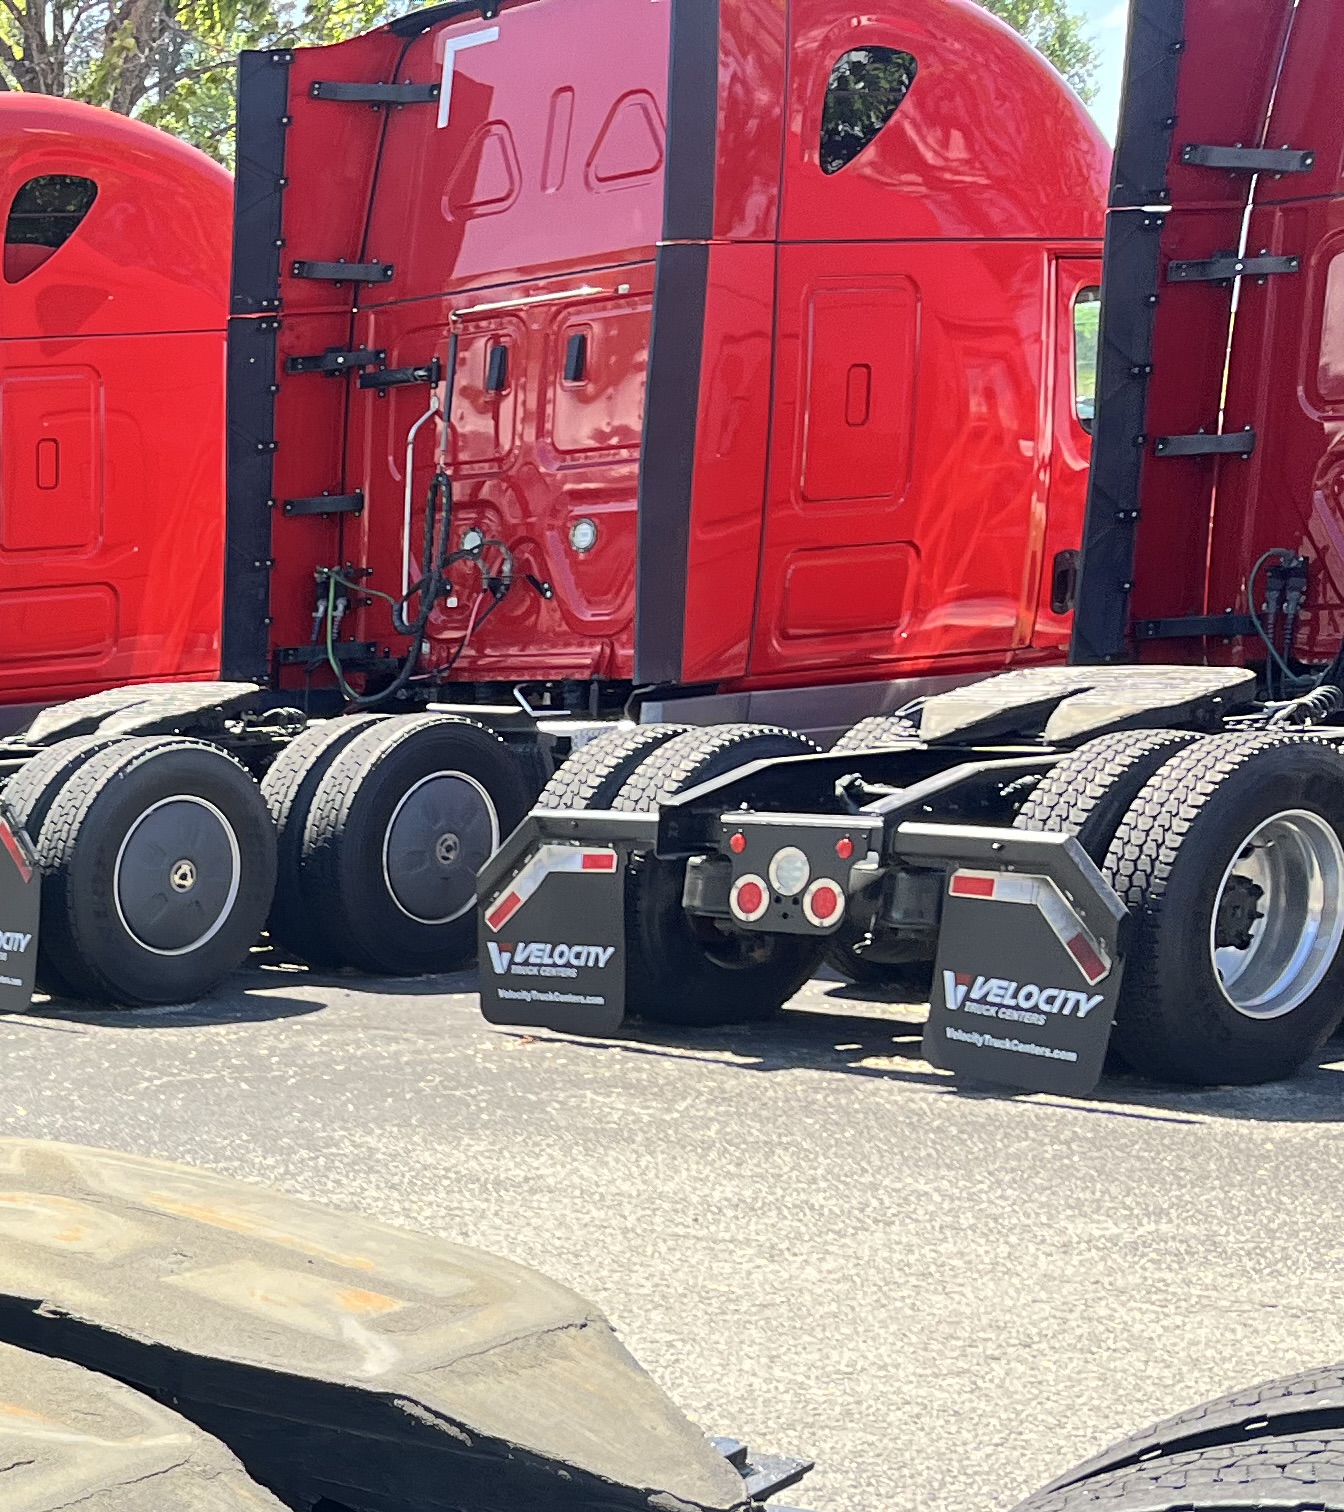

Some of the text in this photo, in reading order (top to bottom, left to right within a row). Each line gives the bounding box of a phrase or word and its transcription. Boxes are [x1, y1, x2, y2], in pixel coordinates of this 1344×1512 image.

[513, 942, 615, 968] VELOCITY
[969, 975, 1105, 1018] VELOCITY
[964, 1001, 1047, 1026] TRUCK CENTERS
[945, 1026, 1078, 1062] VelocityTruckCenters.com
